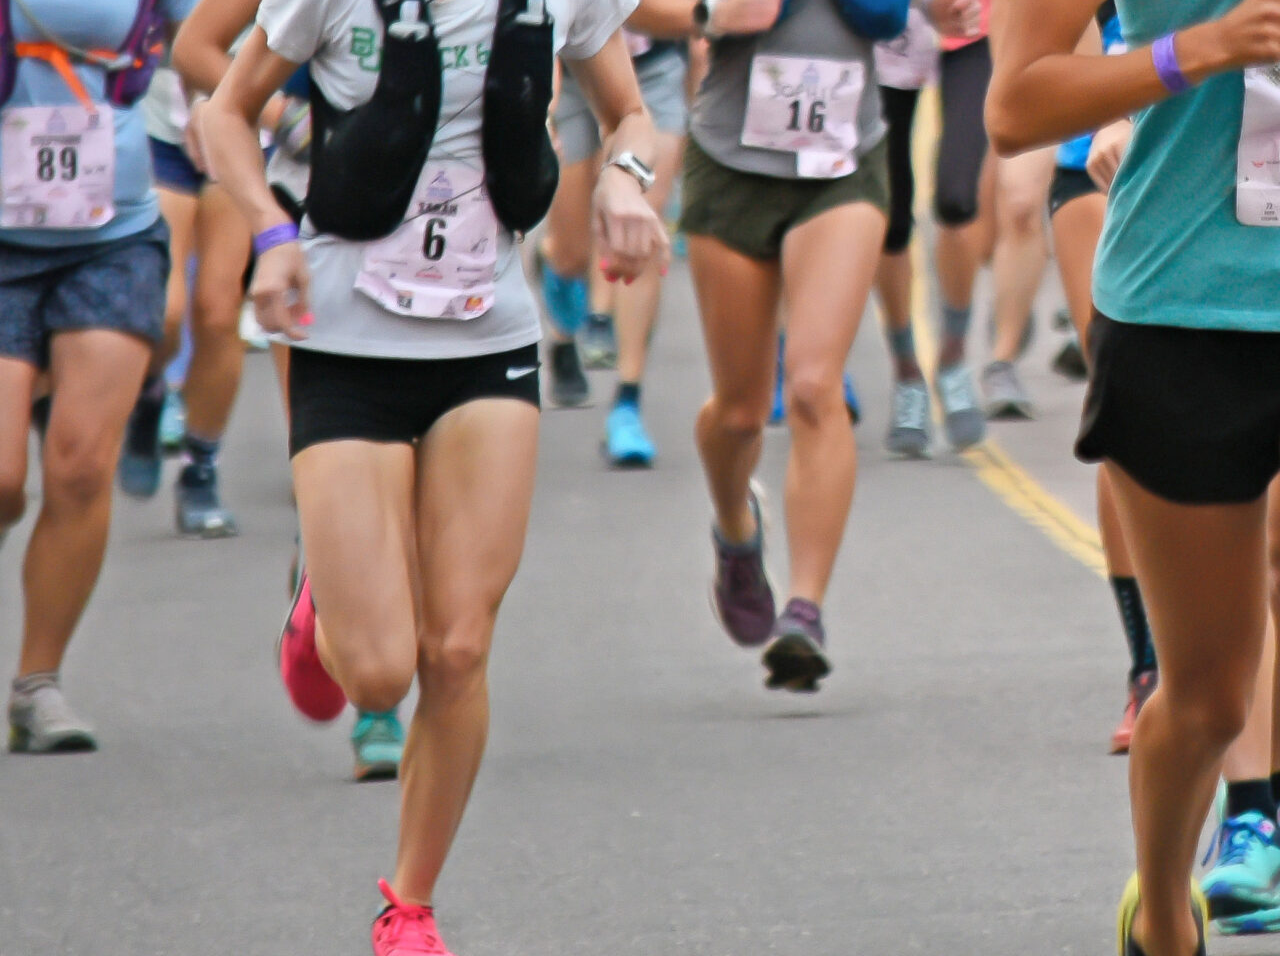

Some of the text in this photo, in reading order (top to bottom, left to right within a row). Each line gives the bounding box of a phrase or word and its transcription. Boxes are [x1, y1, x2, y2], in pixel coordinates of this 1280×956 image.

[786, 99, 827, 133] 16
[37, 147, 78, 181] 89
[422, 217, 447, 262] 6
